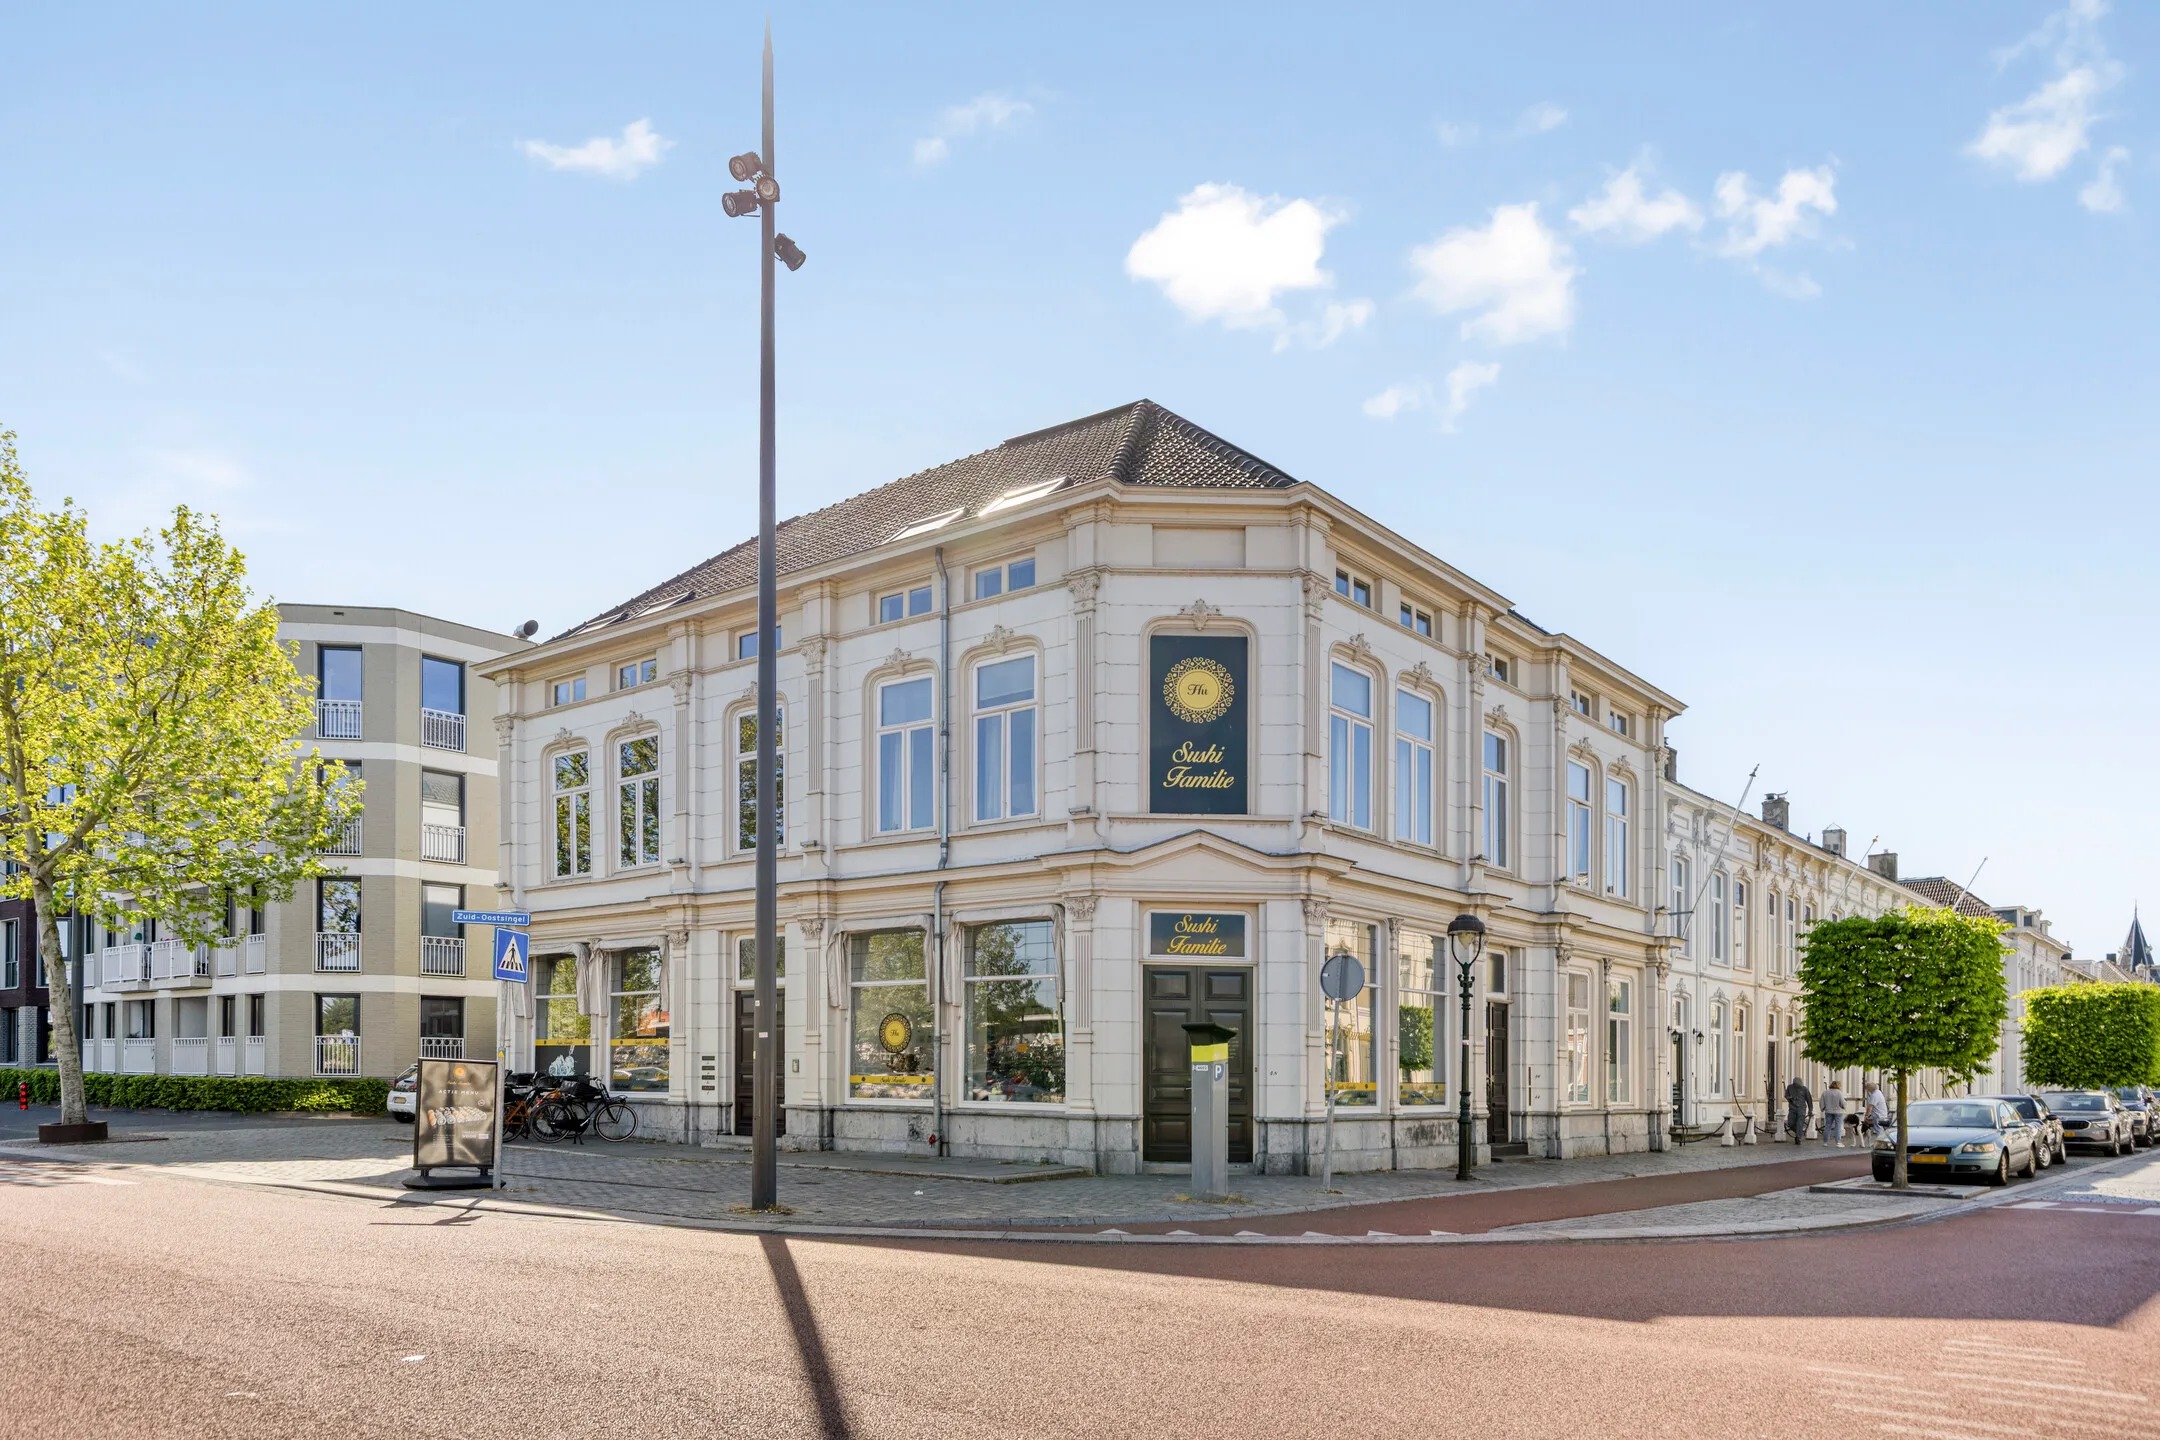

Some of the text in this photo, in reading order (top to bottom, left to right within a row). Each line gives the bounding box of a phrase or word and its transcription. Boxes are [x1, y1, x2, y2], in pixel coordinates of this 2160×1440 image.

[1172, 742, 1223, 763] Sushi
[1163, 766, 1233, 788] Familie
[456, 912, 526, 924] Zuid-Oostsingel
[1174, 914, 1218, 933] Sushi
[1166, 935, 1227, 955] Familie
[1214, 1065, 1222, 1079] P
